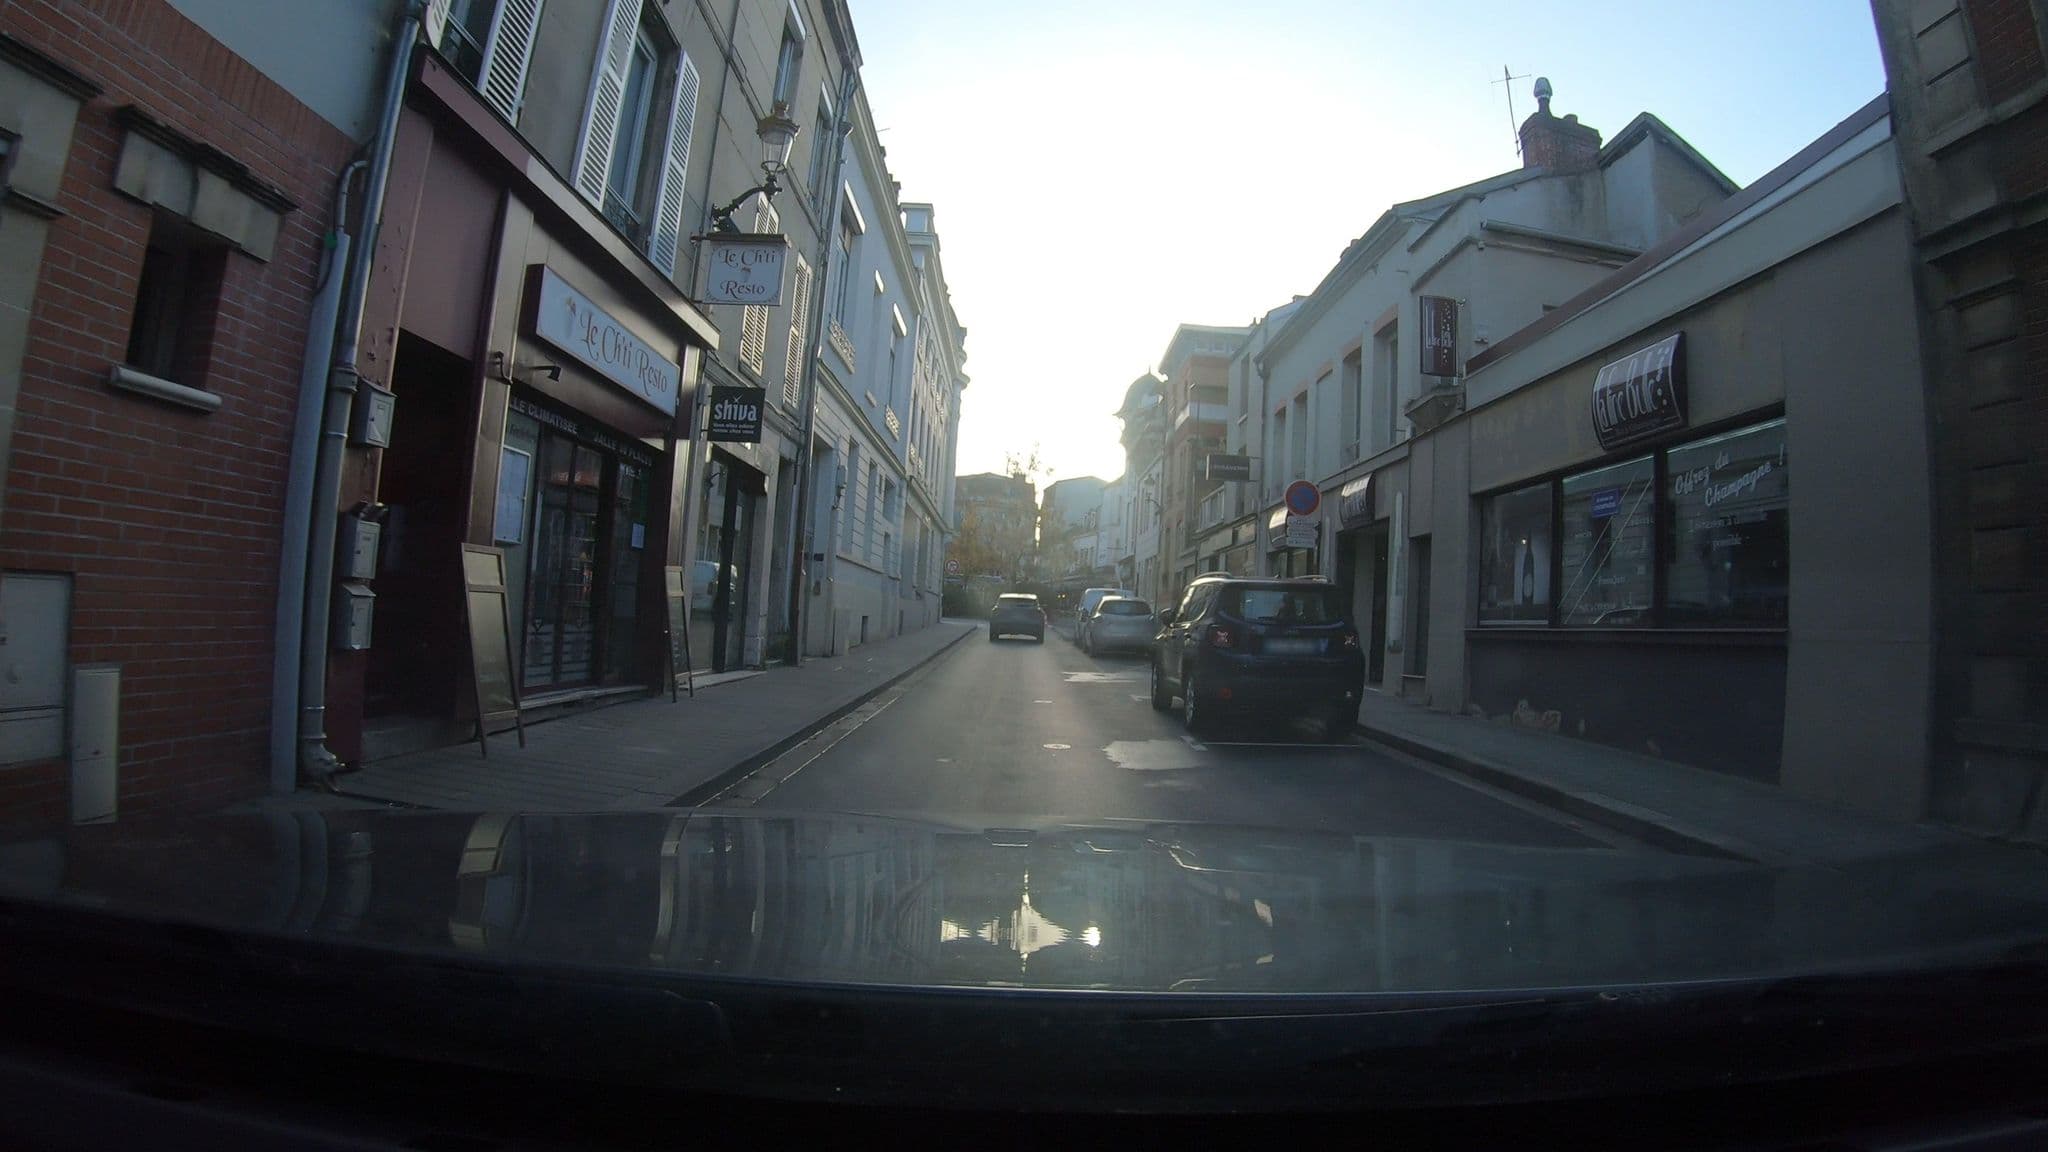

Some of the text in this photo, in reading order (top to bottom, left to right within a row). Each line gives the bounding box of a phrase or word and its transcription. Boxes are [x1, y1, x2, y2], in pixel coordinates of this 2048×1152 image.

[718, 249, 776, 268] Le Ch'ti
[720, 281, 766, 301] Resto
[580, 309, 668, 396] Le Ch'ti Resto
[714, 399, 758, 422] shiva
[1675, 450, 1730, 495] Offrez du
[1704, 461, 1773, 507] Champagne
